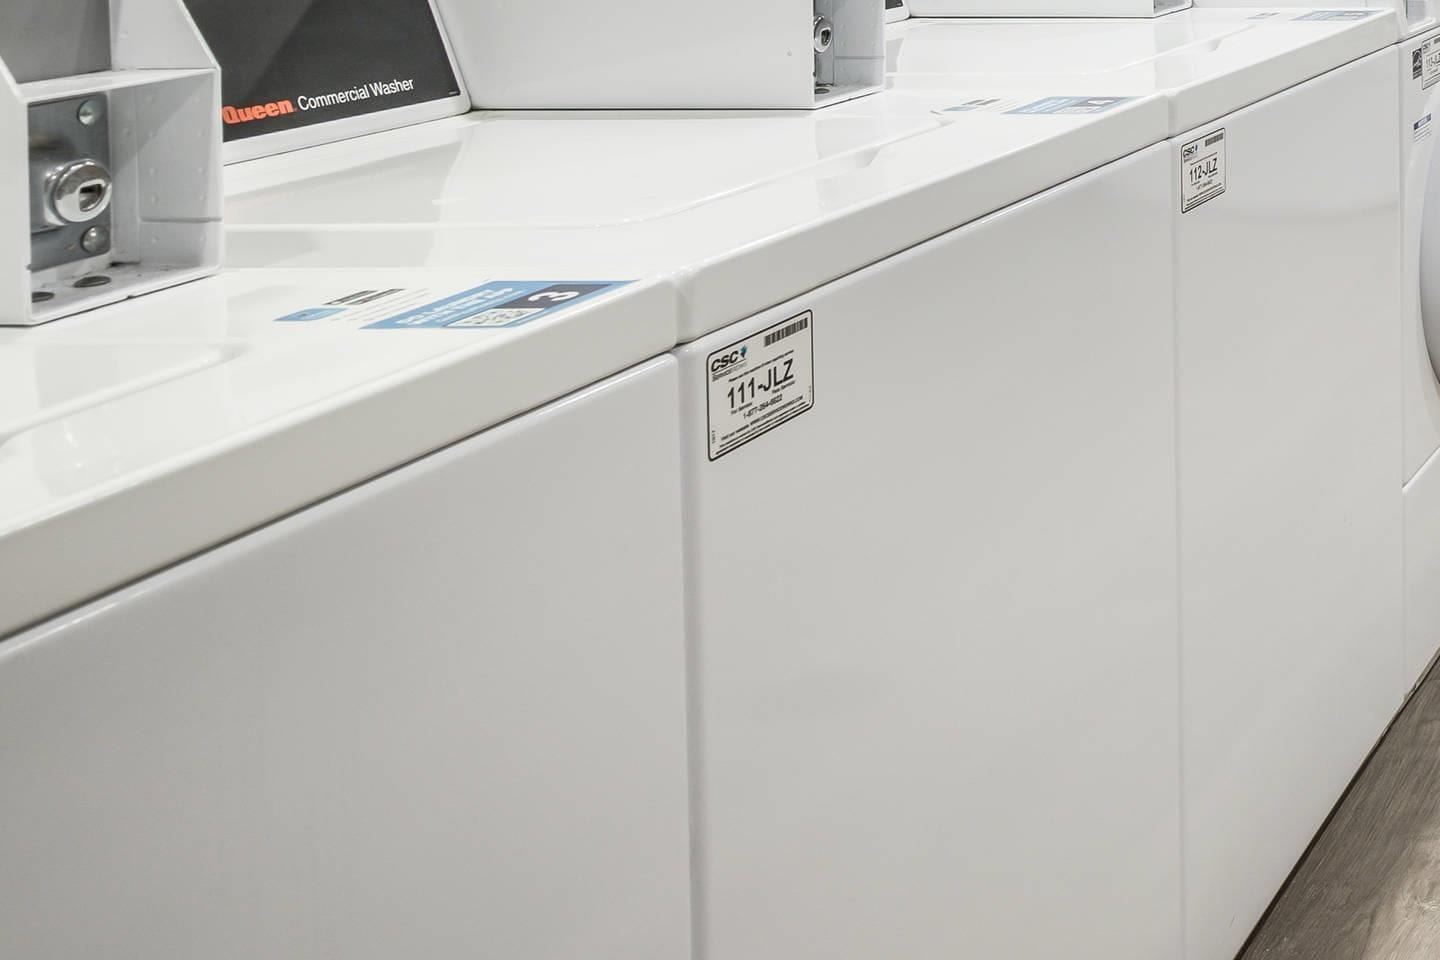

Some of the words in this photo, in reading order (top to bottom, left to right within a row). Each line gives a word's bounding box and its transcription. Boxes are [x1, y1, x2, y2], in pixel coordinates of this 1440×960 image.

[222, 98, 293, 125] Queen
[297, 83, 370, 112] Commercial
[369, 77, 415, 98] Washer
[1189, 157, 1218, 183] 112-JLZ
[528, 290, 580, 302] 3
[711, 350, 739, 372] CSC
[727, 358, 794, 408] 111-JLZ
